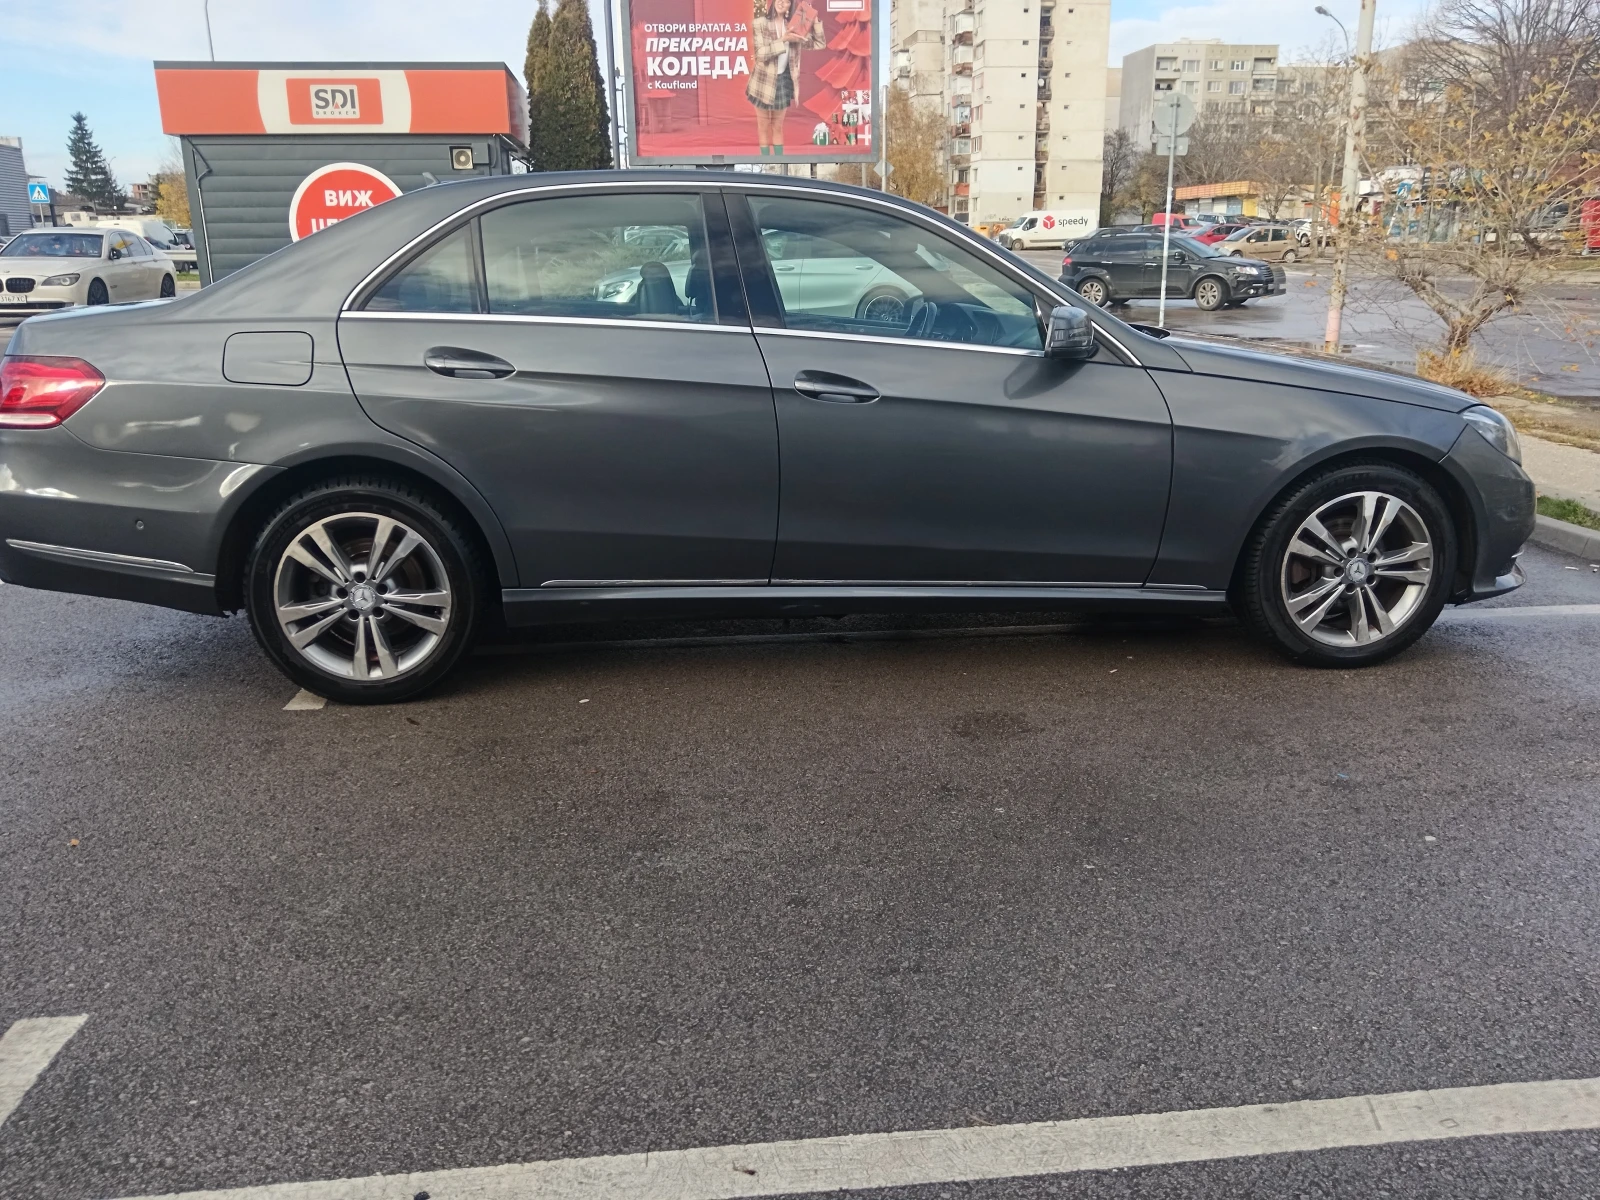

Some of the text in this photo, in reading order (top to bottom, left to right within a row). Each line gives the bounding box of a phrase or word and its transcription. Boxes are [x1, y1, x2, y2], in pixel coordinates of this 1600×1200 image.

[644, 23, 747, 33] ОТВОРИ ВРАТАТА ЗА
[645, 37, 749, 52] ПРЕКРАСНА
[647, 56, 749, 79] КОЛЕДА
[655, 80, 698, 89] Kaufland
[314, 88, 357, 110] SDI
[324, 189, 375, 208] ВИЖ
[1058, 216, 1089, 228] speedy
